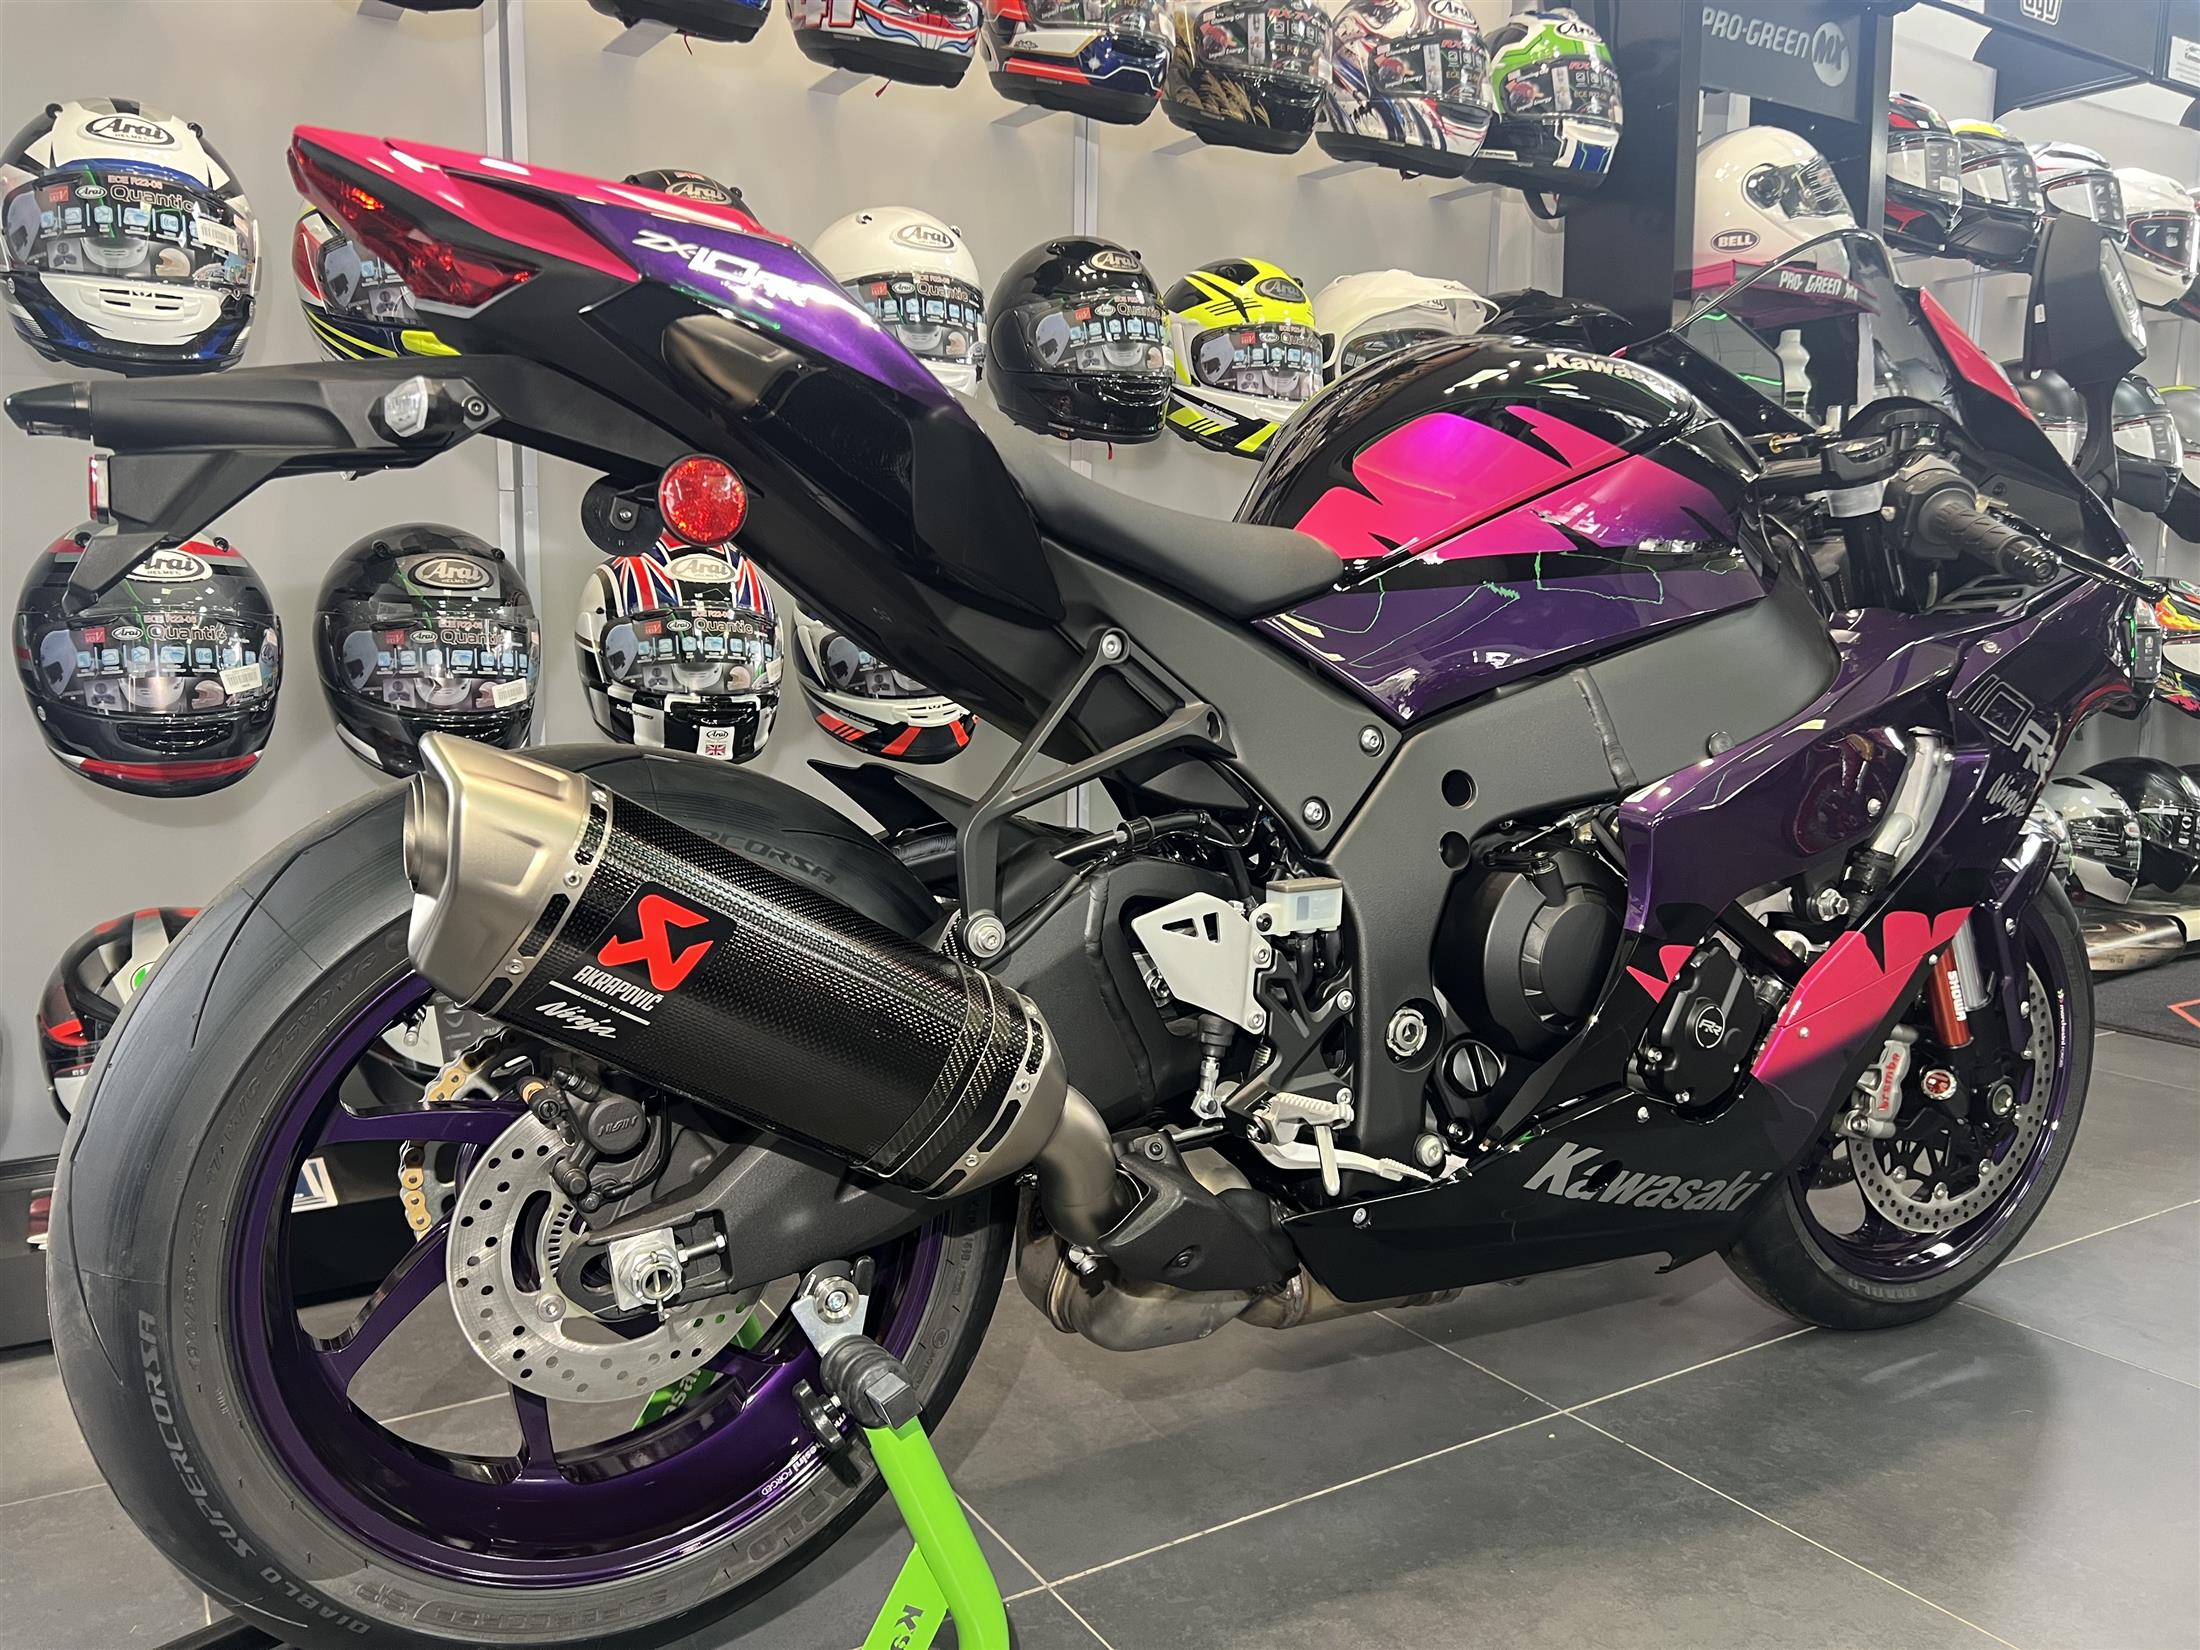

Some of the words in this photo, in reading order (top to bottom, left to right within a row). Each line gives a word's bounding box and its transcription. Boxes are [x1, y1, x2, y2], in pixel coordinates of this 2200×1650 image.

[95, 118, 164, 142] Arai
[110, 185, 195, 213] Quantic
[900, 226, 948, 243] Arai
[1718, 234, 1754, 248] BELL
[423, 562, 482, 581] Arai
[113, 628, 142, 638] Arai
[147, 624, 227, 641] Quantic
[412, 632, 437, 641] Arai
[694, 618, 754, 635] Quantic
[1947, 970, 1967, 1021] SHOWA
[535, 1001, 617, 1039] Ninja
[1523, 1141, 1773, 1212] Kawasaki
[138, 1309, 257, 1560] SUPERCORSA
[259, 1566, 371, 1635] DIABLO
